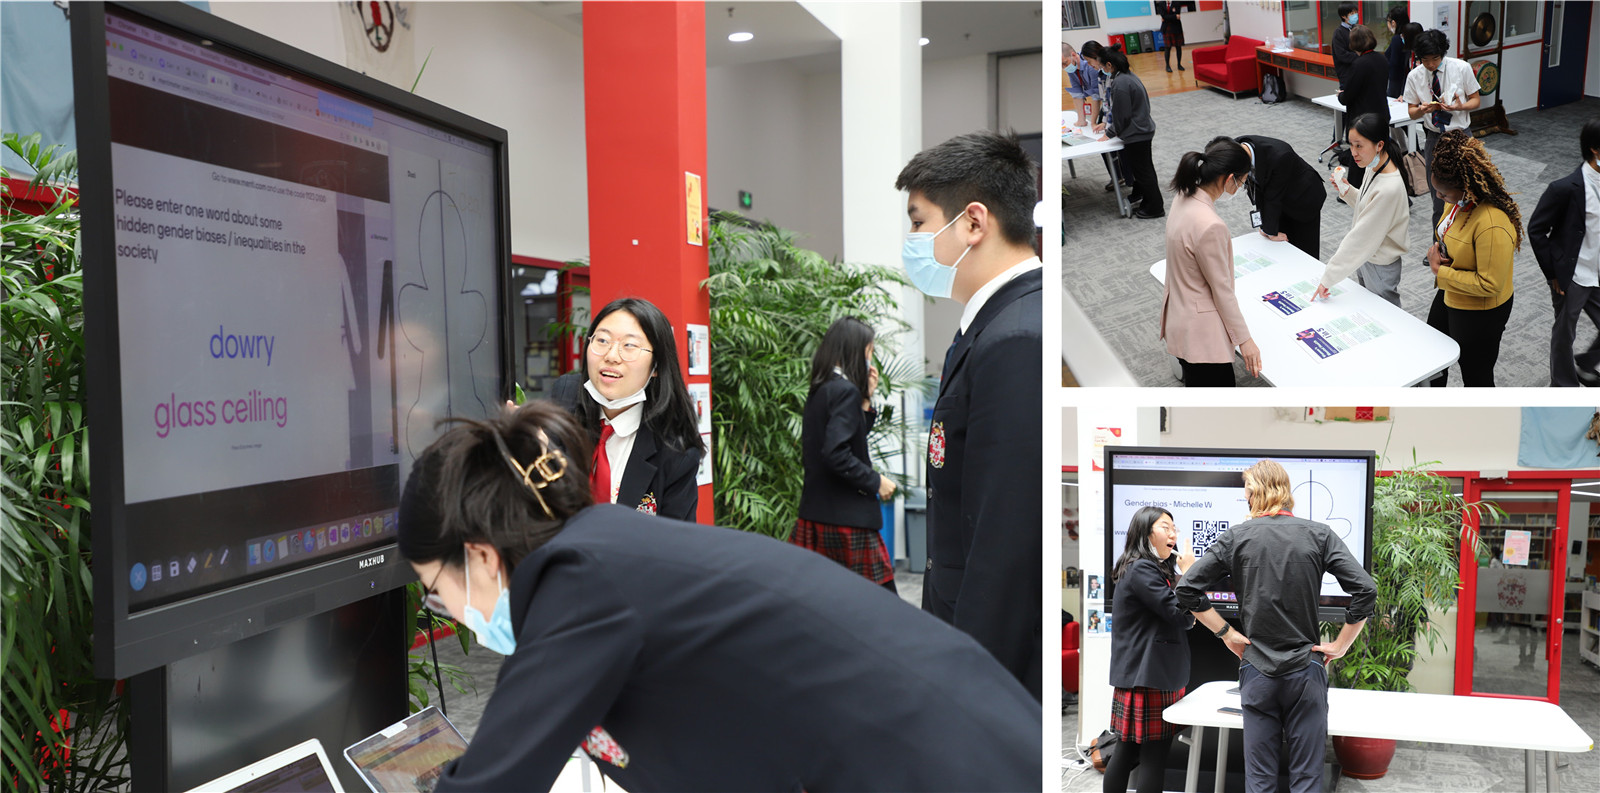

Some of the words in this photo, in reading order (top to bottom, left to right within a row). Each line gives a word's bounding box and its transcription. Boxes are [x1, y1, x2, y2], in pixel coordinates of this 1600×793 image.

[212, 172, 220, 181] Go
[221, 175, 227, 183] to
[228, 177, 266, 191] www.menti.com
[267, 185, 276, 193] and
[285, 188, 294, 196] the
[116, 189, 153, 210] Please
[155, 196, 184, 215] enter
[185, 203, 204, 218] one
[206, 205, 230, 222] word
[231, 209, 258, 227] about
[259, 217, 283, 230] some
[116, 215, 155, 235] hidden
[157, 222, 194, 244] gender
[196, 227, 227, 245] biases
[228, 229, 233, 247] /
[234, 233, 283, 254] inequalities
[285, 239, 293, 252] in
[294, 240, 306, 255] the
[117, 244, 158, 263] society
[210, 325, 275, 366] dowry
[154, 393, 216, 438] glass
[222, 390, 288, 428] ceiling
[1124, 499, 1151, 507] Gender
[1173, 500, 1203, 508] Michelle
[359, 554, 385, 569] MAXHUB
